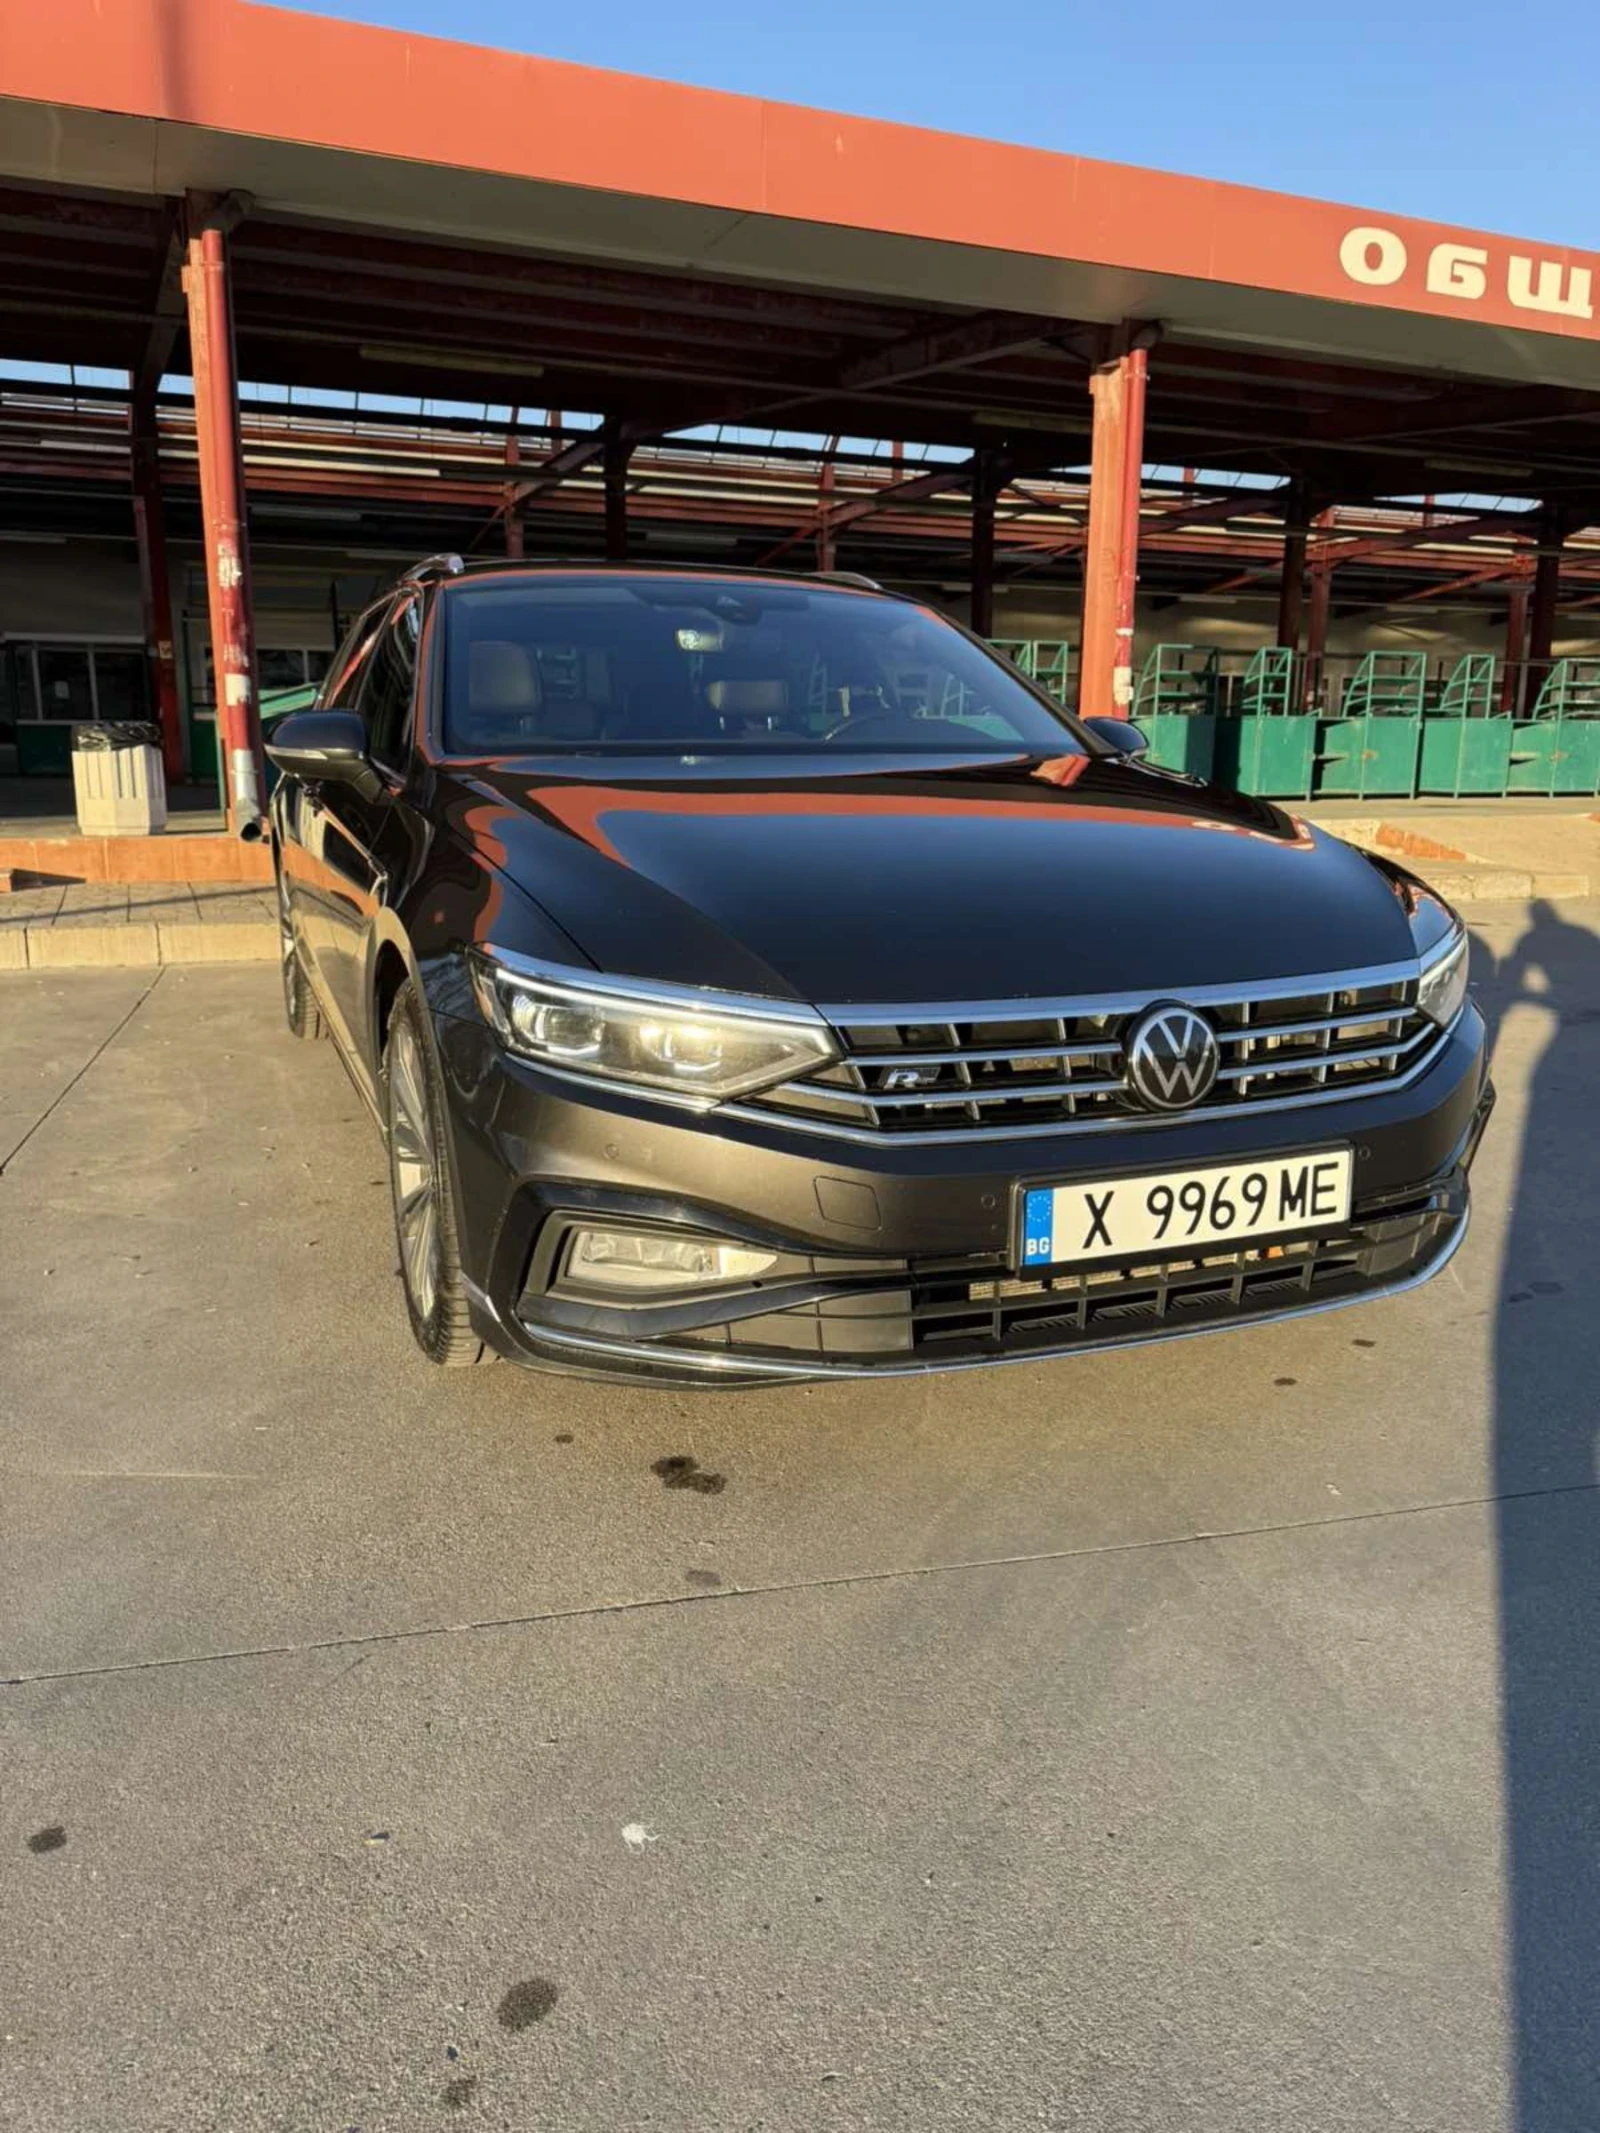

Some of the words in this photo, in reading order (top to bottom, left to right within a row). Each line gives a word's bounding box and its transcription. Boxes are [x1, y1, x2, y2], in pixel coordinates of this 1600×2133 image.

[884, 1071, 919, 1089] R
[1082, 1191, 1114, 1249] X
[1146, 1172, 1268, 1240] 9969
[1279, 1161, 1339, 1222] ME
[1025, 1237, 1050, 1256] BG
